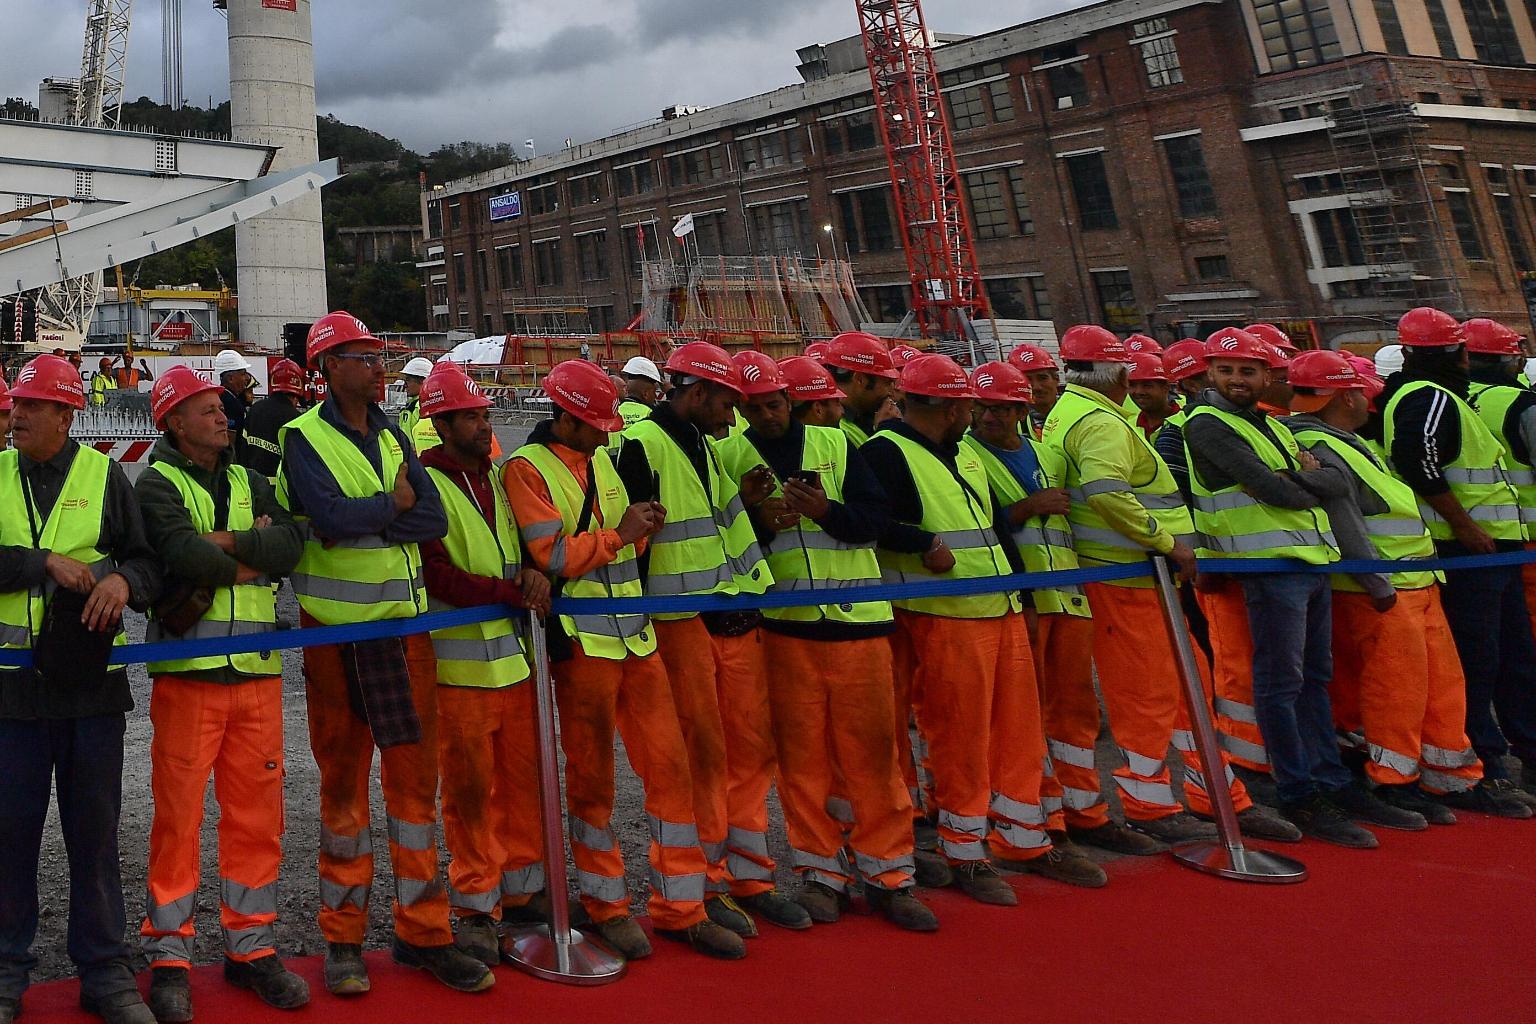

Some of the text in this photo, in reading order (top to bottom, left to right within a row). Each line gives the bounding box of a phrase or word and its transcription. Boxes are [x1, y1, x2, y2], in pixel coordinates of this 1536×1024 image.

[491, 194, 518, 208] ANSALDO
[691, 361, 727, 376] costruzioni
[711, 361, 728, 370] cossi
[159, 383, 173, 396] cossi
[428, 389, 443, 398] cossi
[555, 385, 588, 408] costruzioni
